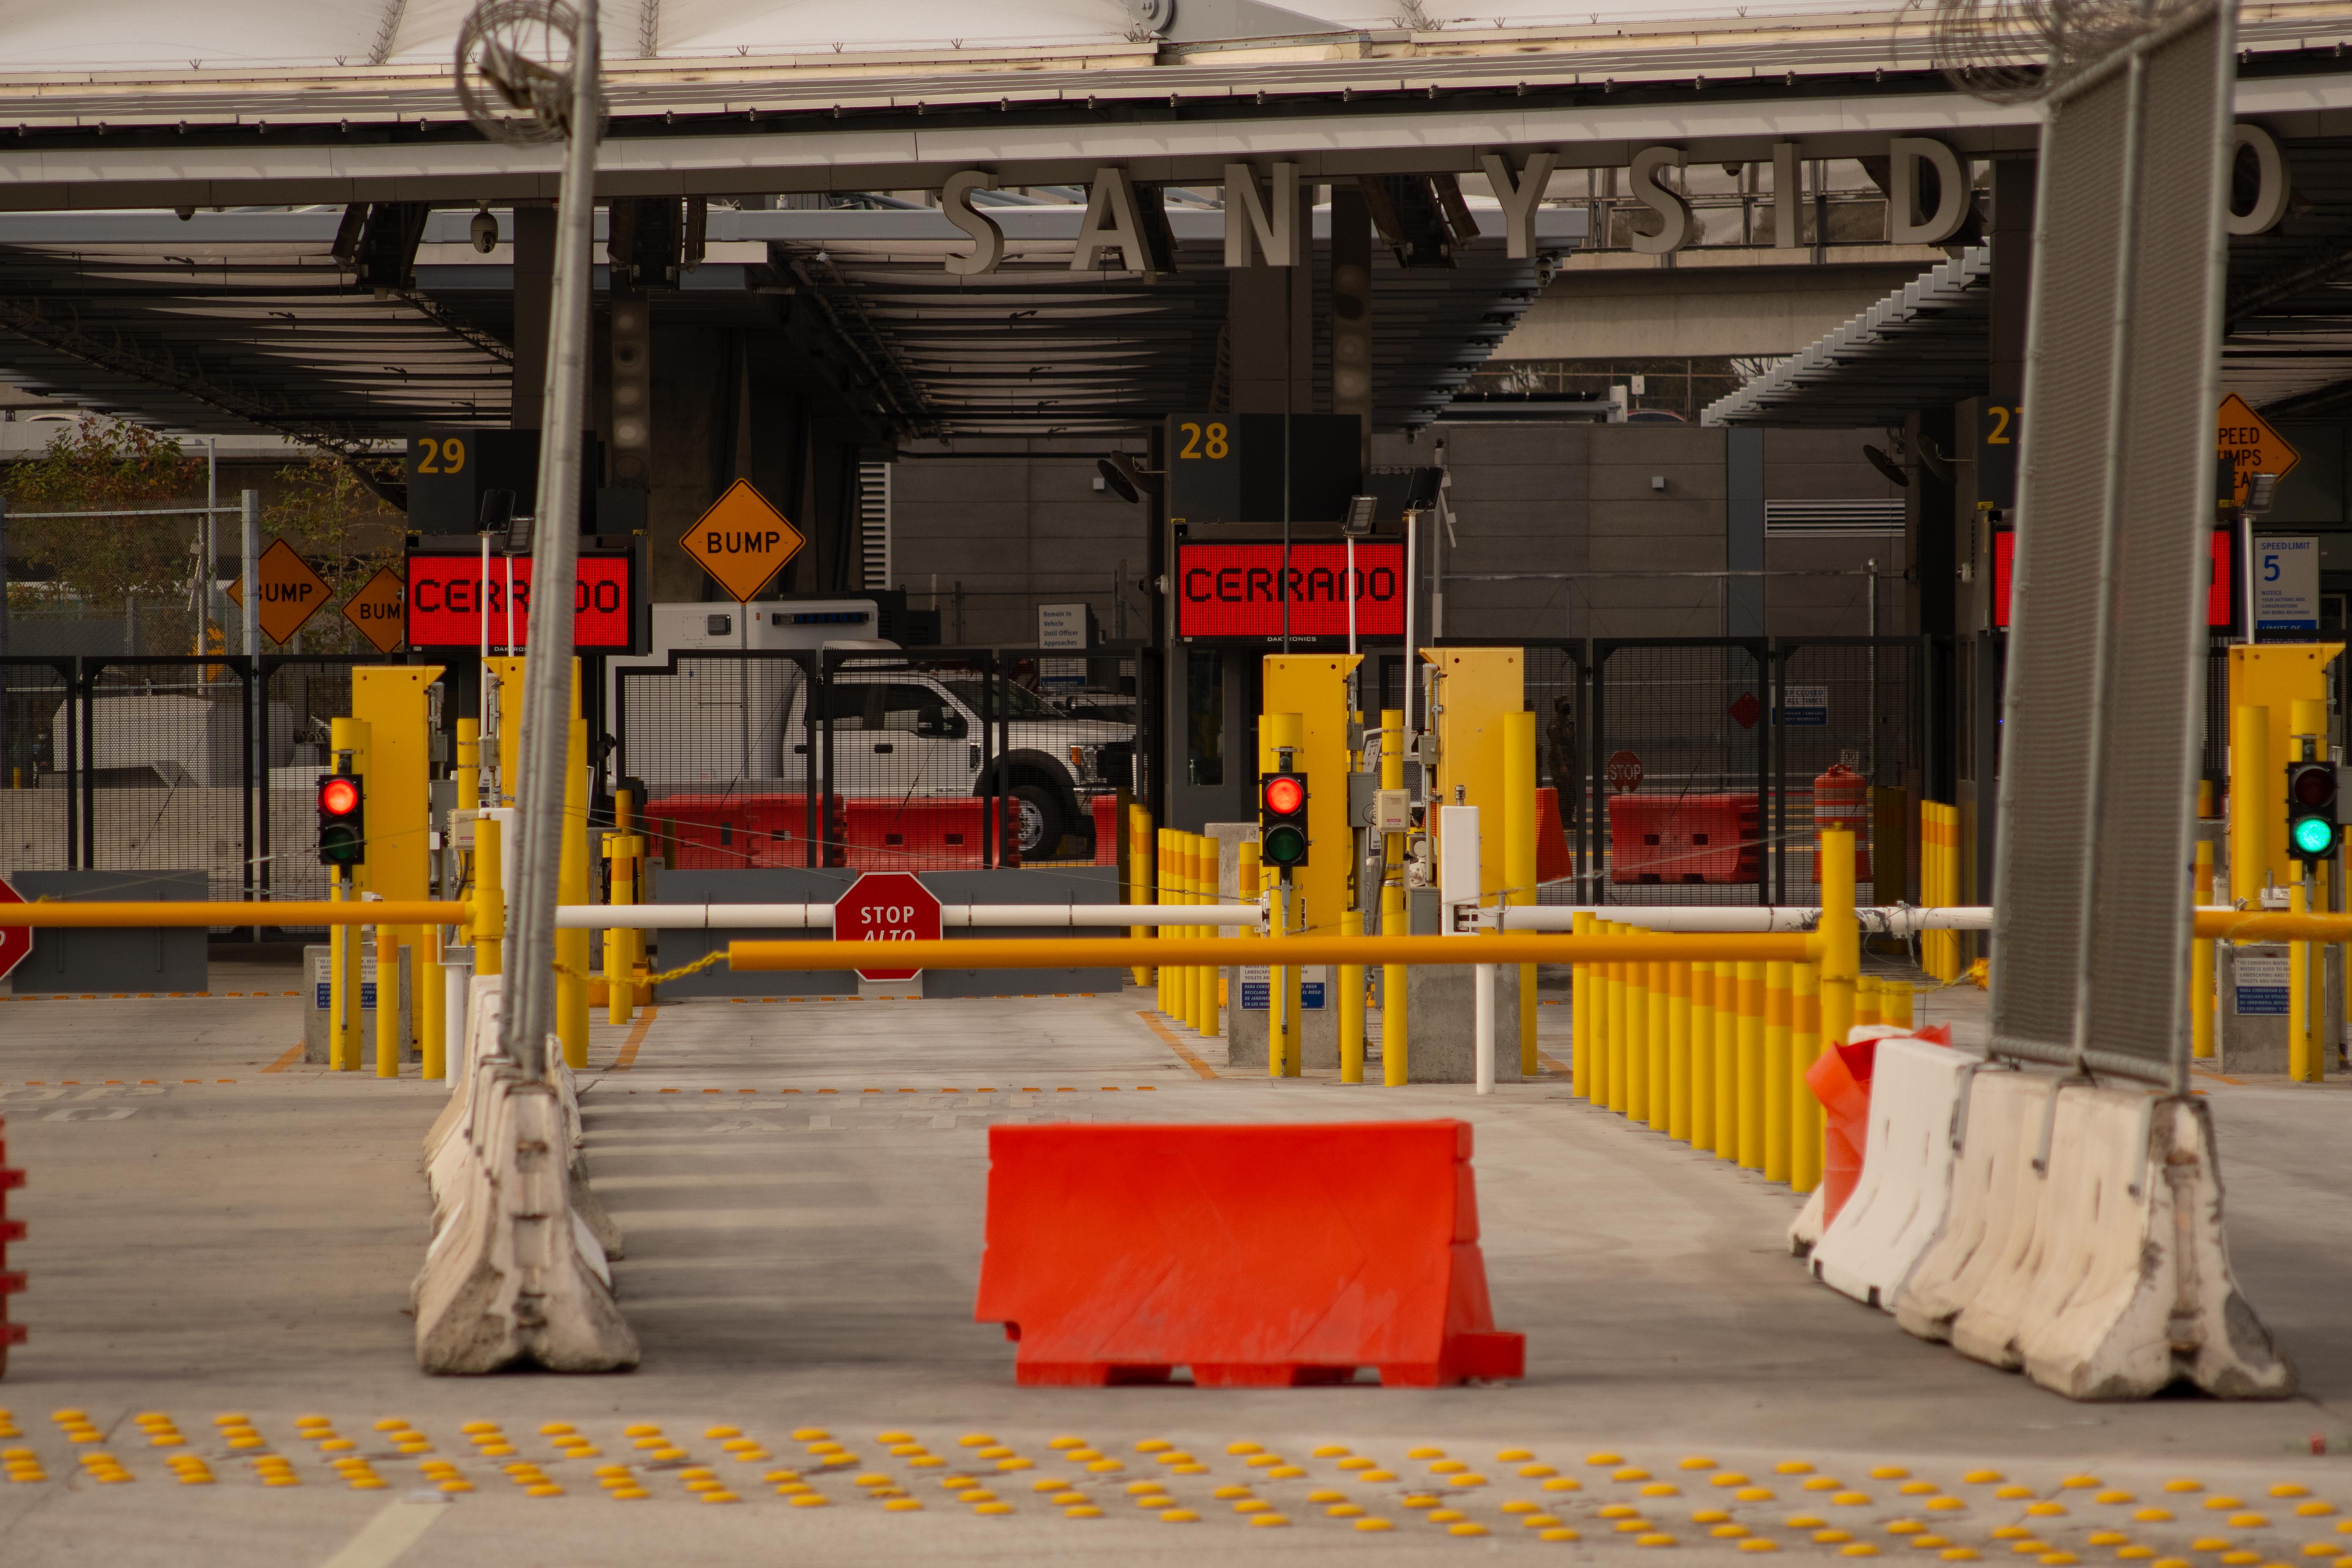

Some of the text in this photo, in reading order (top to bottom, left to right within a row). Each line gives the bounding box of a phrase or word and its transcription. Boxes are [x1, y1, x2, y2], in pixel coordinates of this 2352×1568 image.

[942, 123, 2290, 275] SAN YSIDO
[1180, 422, 1228, 459] 28
[2219, 427, 2259, 444] PEED
[417, 438, 465, 474] 29
[707, 531, 781, 554] BUMP
[2264, 555, 2280, 581] 5
[259, 583, 312, 602] UMP
[415, 580, 619, 612] CERRDO
[1185, 568, 1395, 602] CERRADO
[361, 603, 400, 619] BUM
[1609, 764, 1642, 779] STOP
[861, 906, 914, 924] STOP
